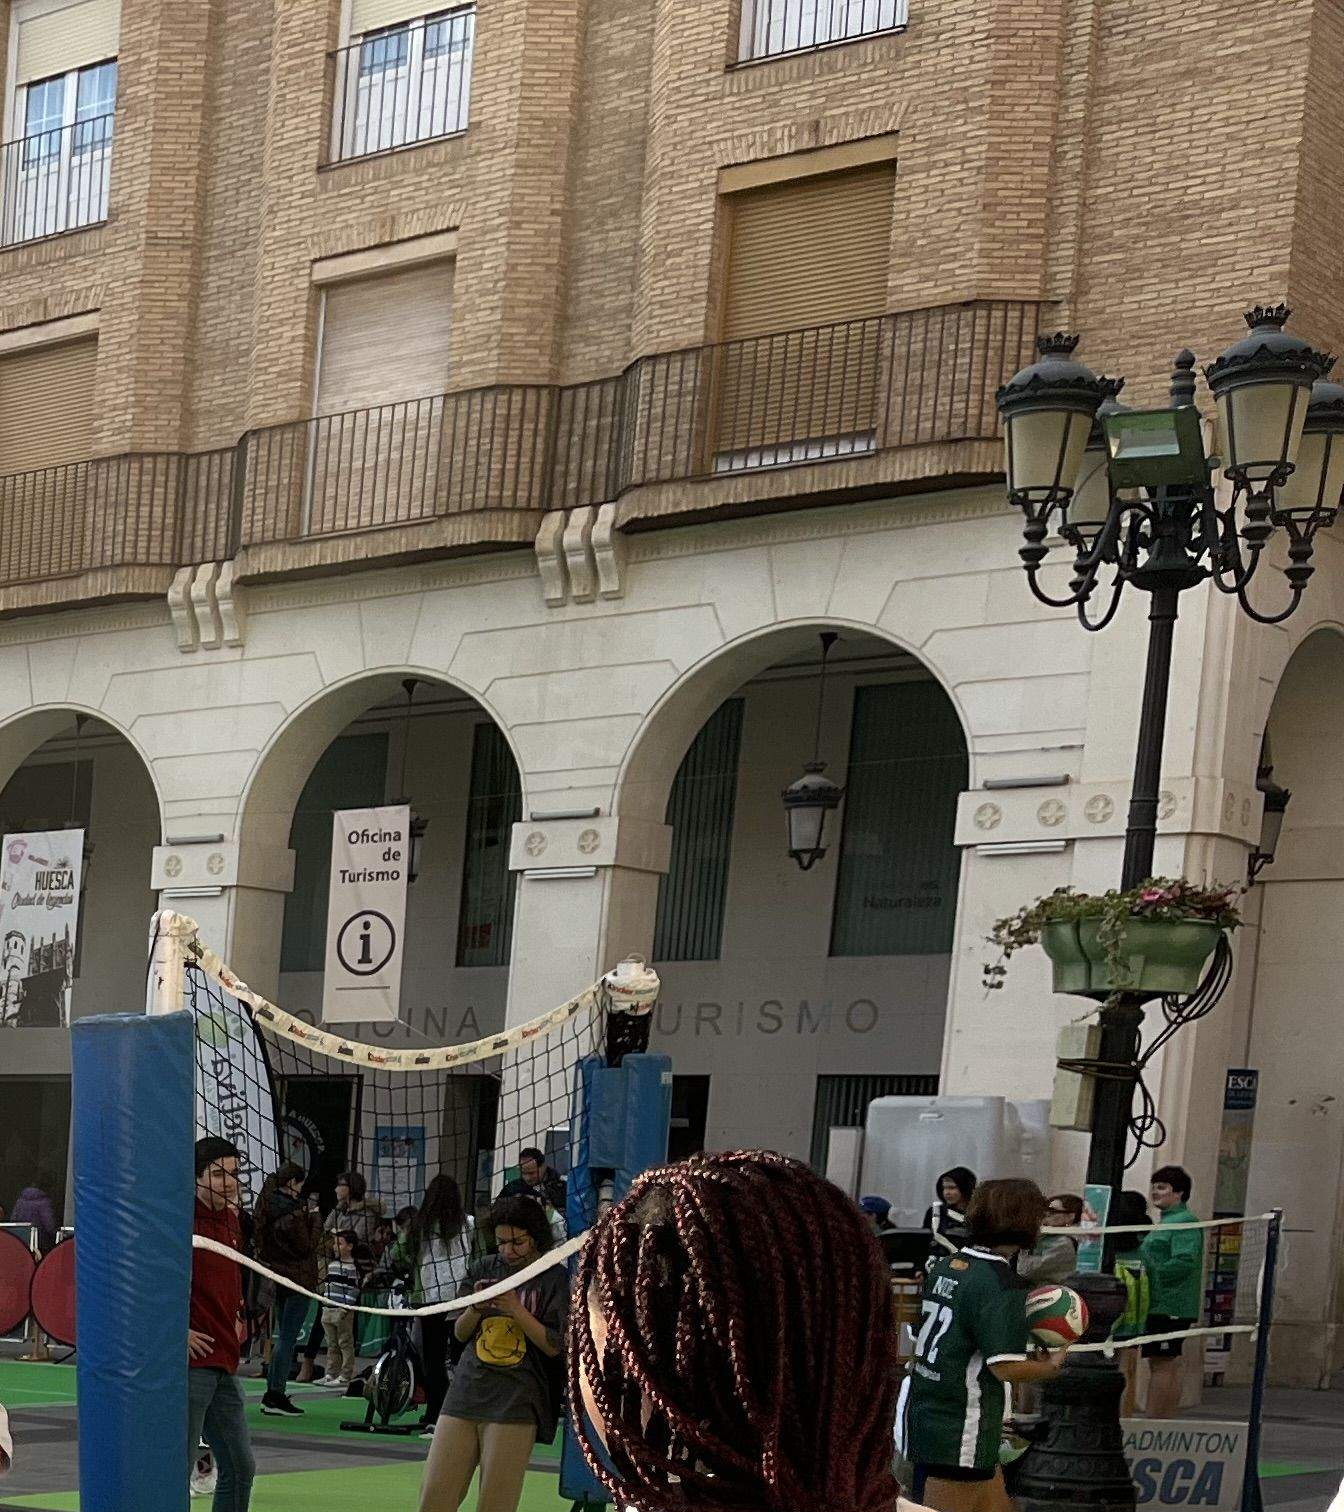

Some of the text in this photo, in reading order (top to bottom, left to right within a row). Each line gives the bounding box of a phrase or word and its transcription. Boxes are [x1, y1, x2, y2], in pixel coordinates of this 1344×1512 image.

[348, 828, 401, 845] Oficina
[382, 847, 401, 862] de
[35, 870, 74, 890] HUESCA
[339, 868, 400, 884] Turismo
[655, 999, 879, 1036] URISMO
[914, 1299, 953, 1364] 72
[1121, 1430, 1239, 1453] ADMINTON
[1125, 1458, 1225, 1506] SCA
